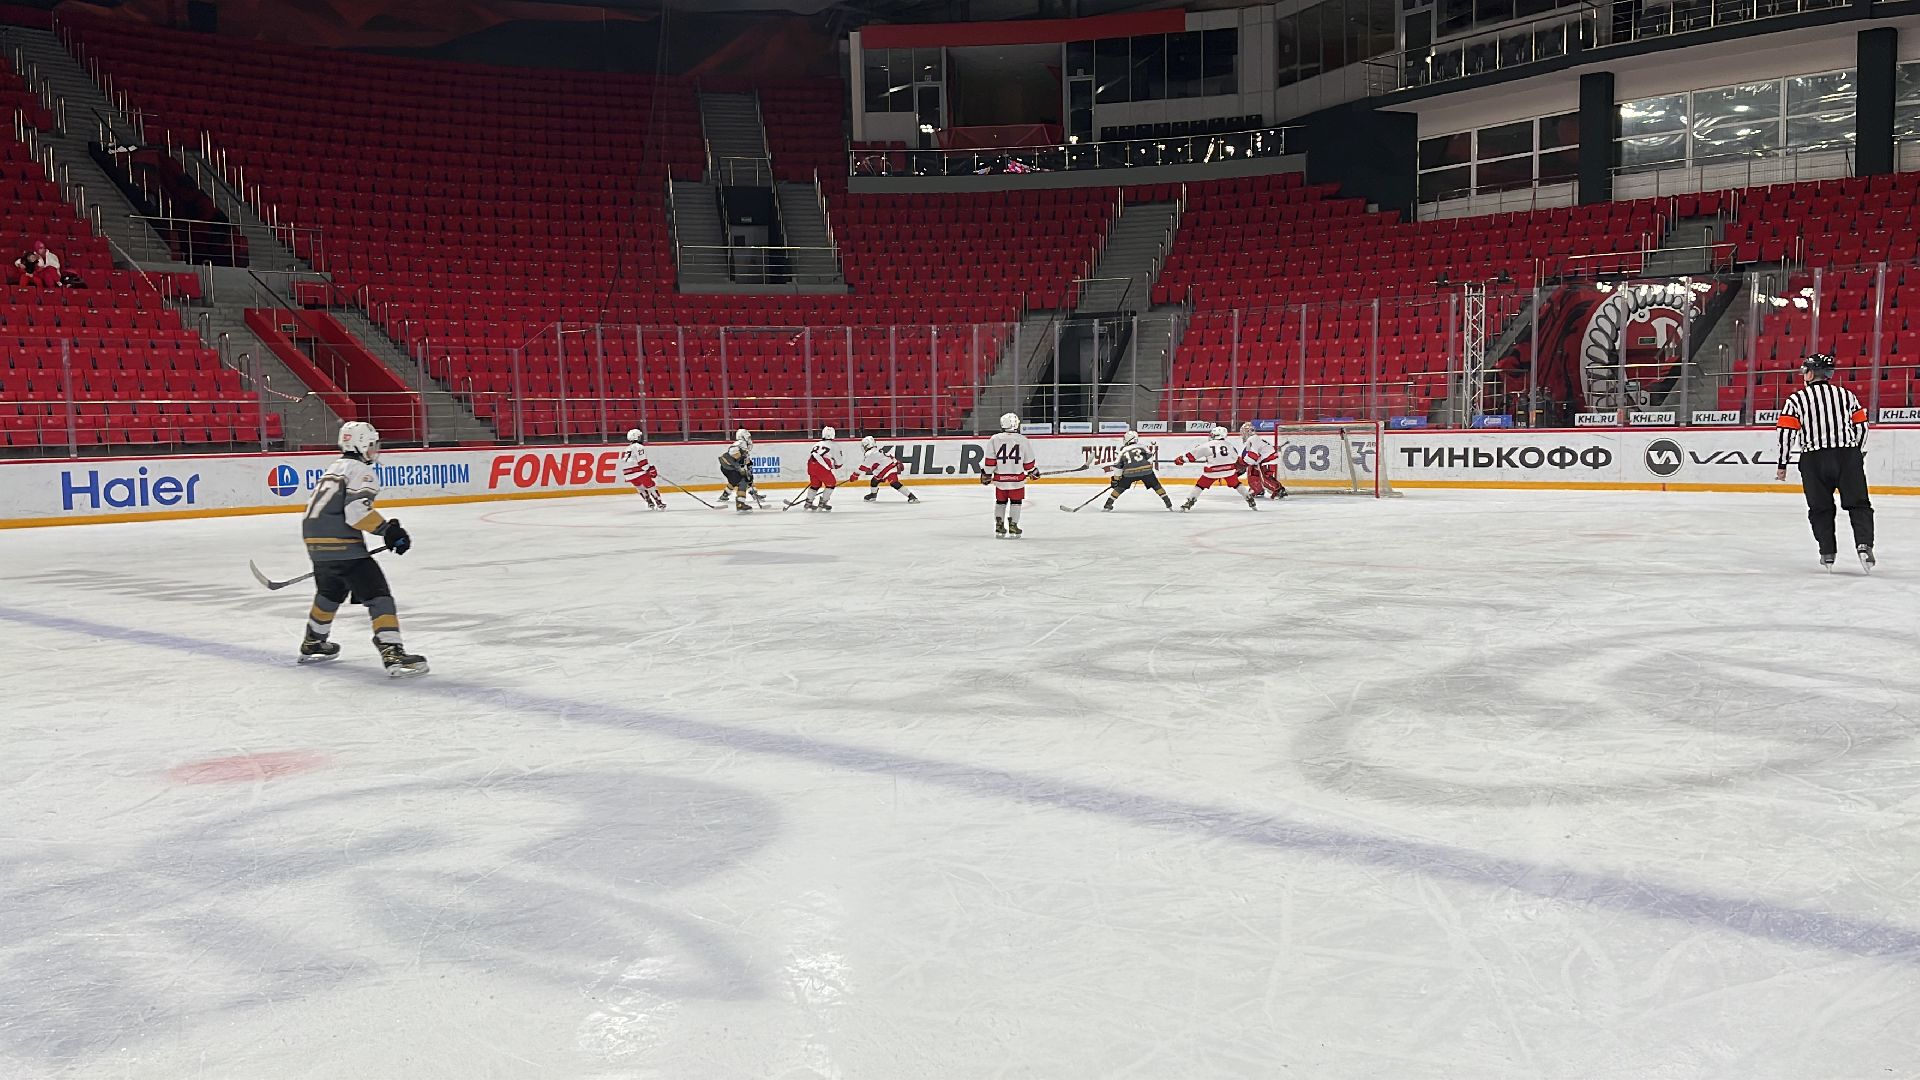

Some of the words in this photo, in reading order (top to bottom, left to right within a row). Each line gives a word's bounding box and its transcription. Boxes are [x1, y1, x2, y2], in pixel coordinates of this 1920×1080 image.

[1577, 413, 1616, 424] KHL.RU
[1632, 413, 1672, 423] KHL.RU
[1695, 413, 1737, 422] KHL.RU
[1758, 411, 1779, 421] KHL
[881, 444, 985, 475] HL.R
[995, 443, 1022, 465] 44
[1123, 447, 1144, 465] 13
[1400, 445, 1613, 470] ТИНЬКОФФ
[488, 451, 626, 490] FONBE
[61, 466, 200, 511] Haier
